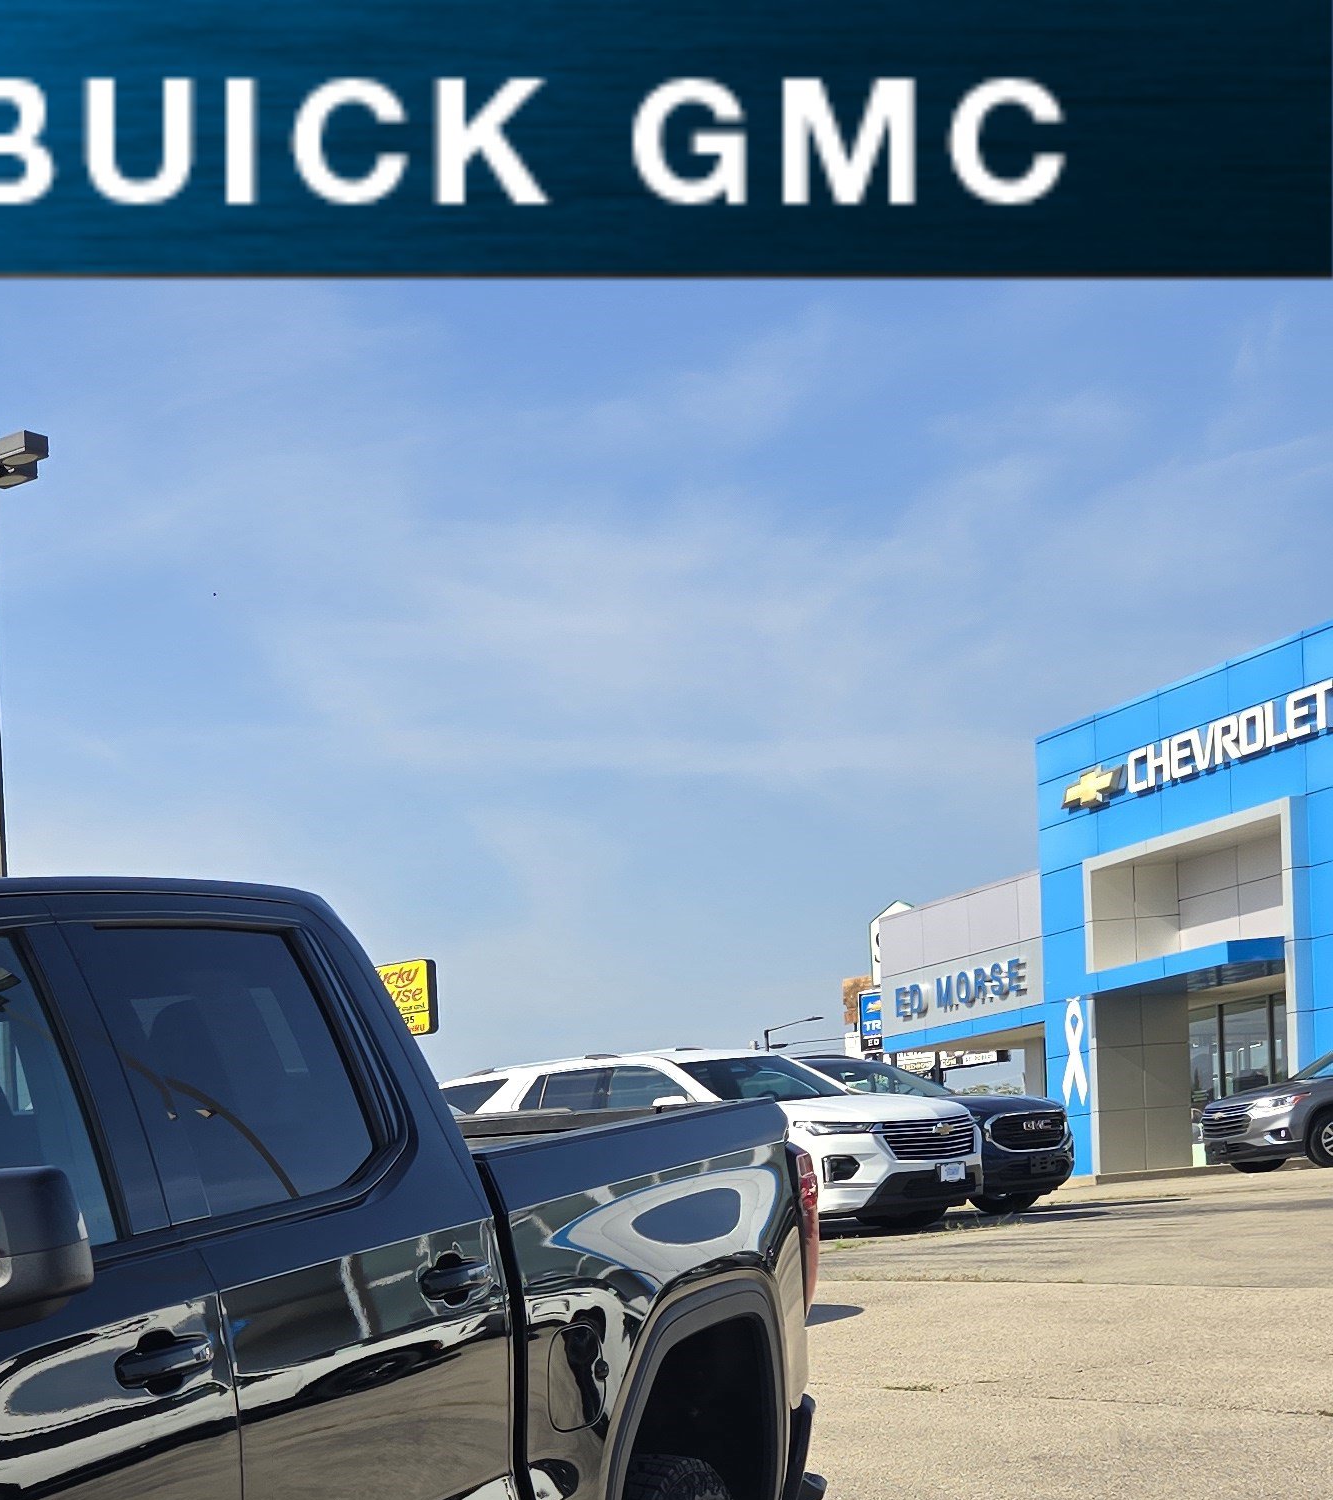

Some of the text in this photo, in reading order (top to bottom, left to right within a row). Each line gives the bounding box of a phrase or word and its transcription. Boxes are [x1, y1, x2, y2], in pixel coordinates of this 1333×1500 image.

[1127, 679, 1333, 794] CHEVROLET
[894, 957, 1022, 1018] ED MORSE
